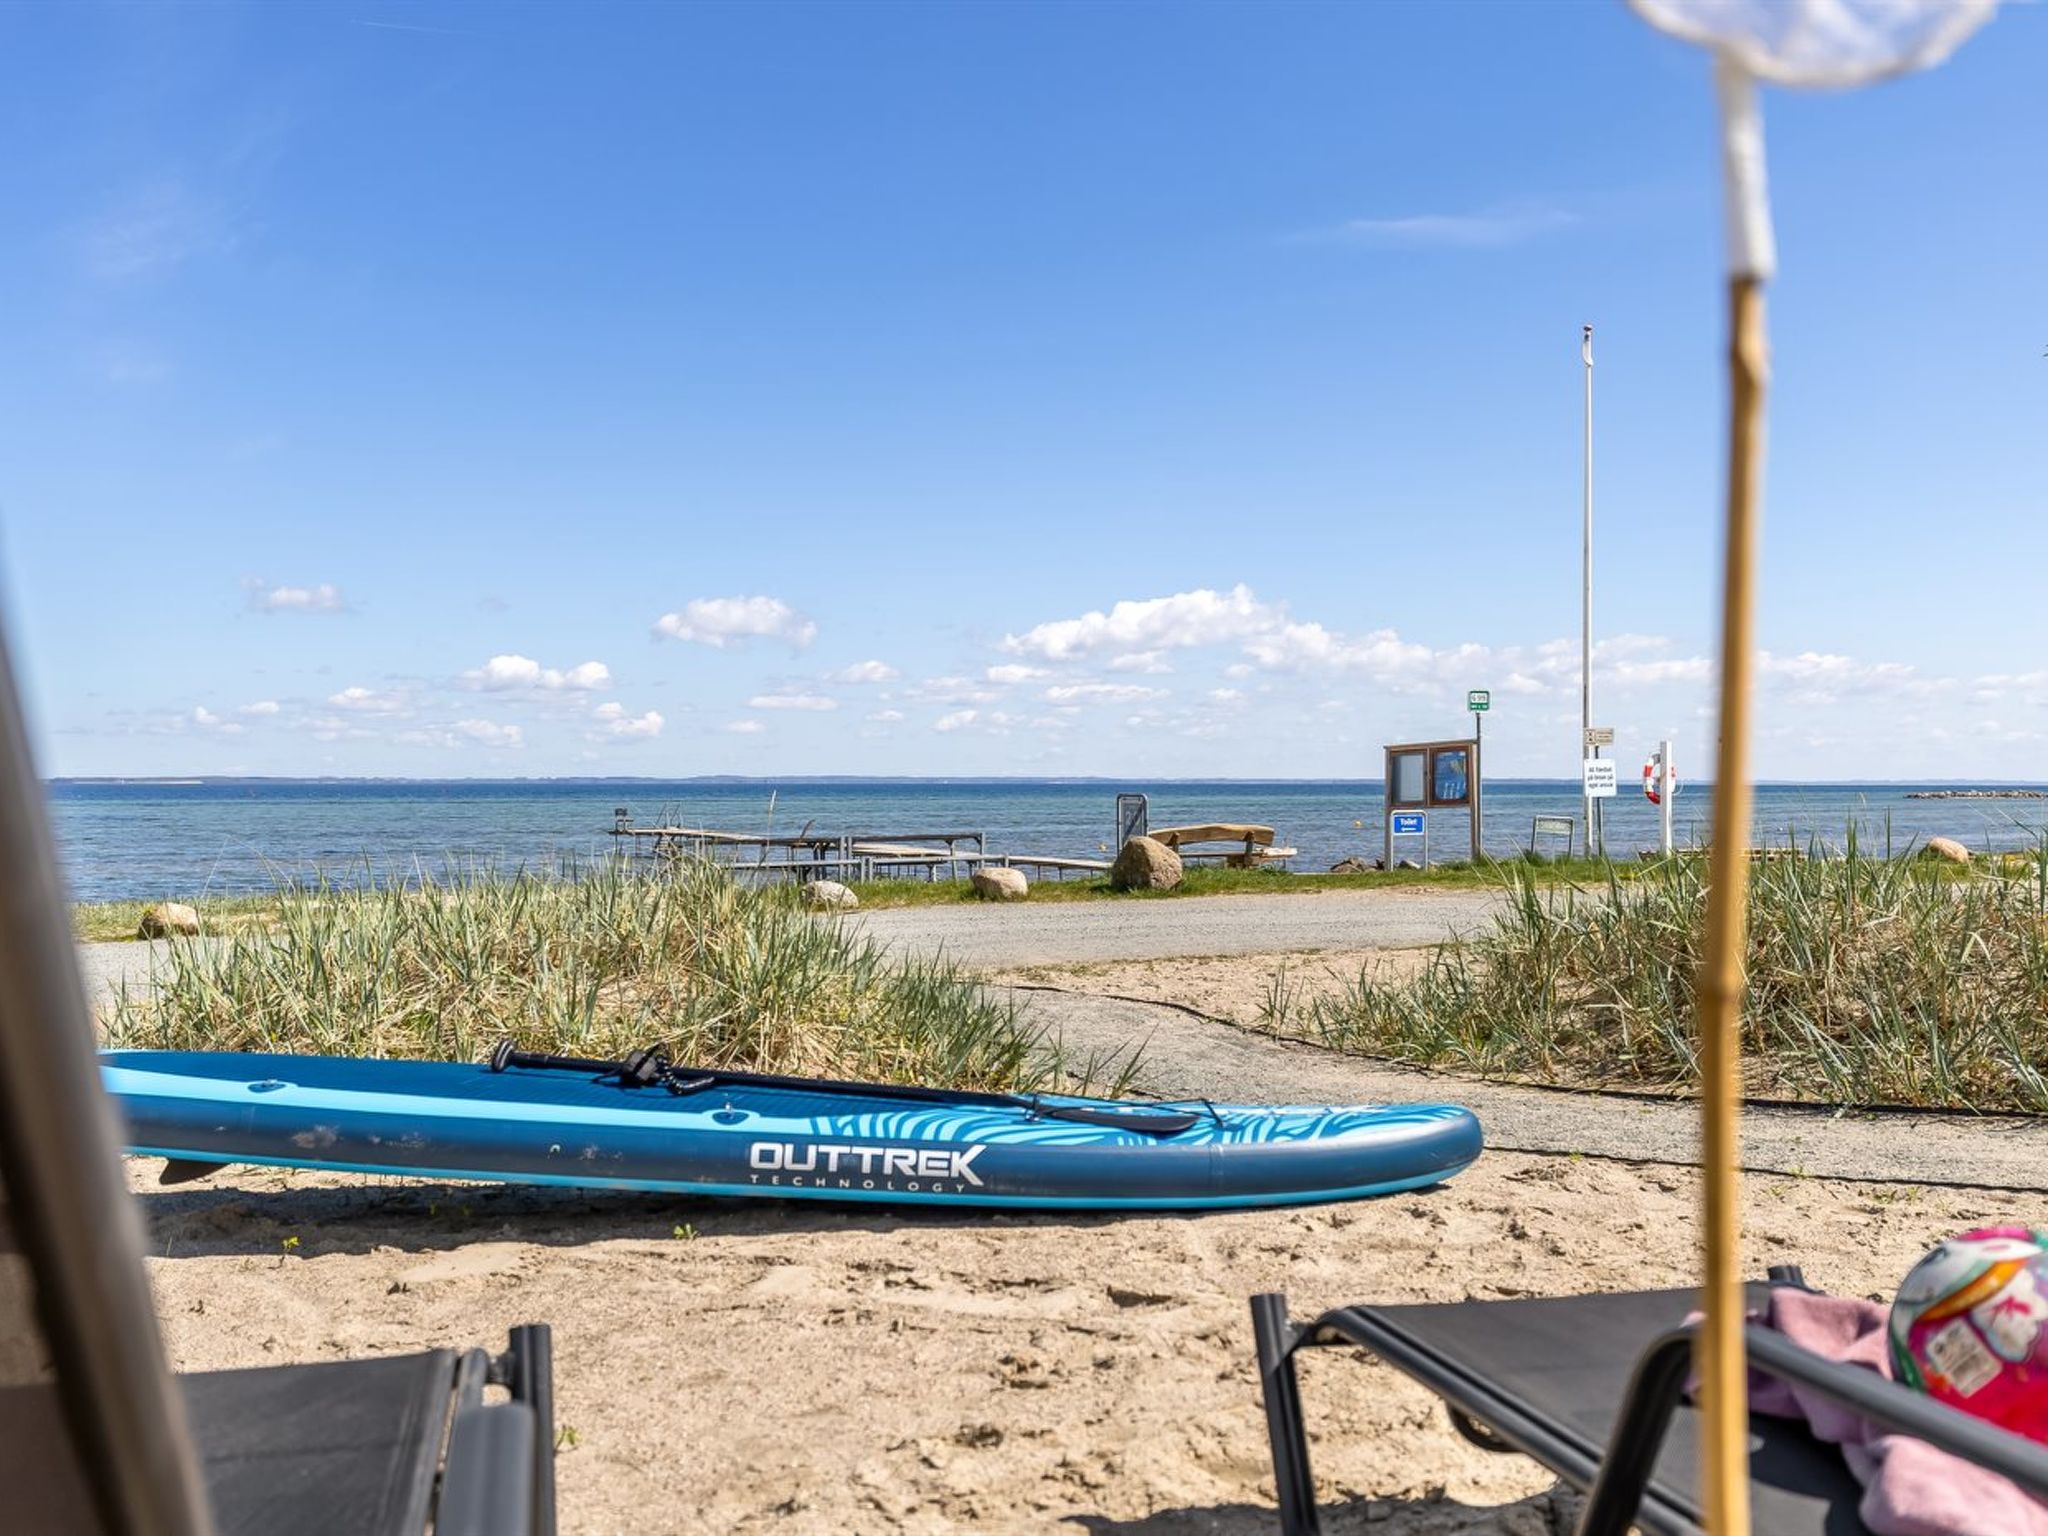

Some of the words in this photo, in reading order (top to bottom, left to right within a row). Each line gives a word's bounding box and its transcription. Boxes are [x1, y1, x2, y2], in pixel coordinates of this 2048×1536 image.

[1400, 818, 1418, 826] Toilet
[750, 1142, 987, 1186] OUTTREK
[750, 1174, 965, 1193] TECHNOLOGY
